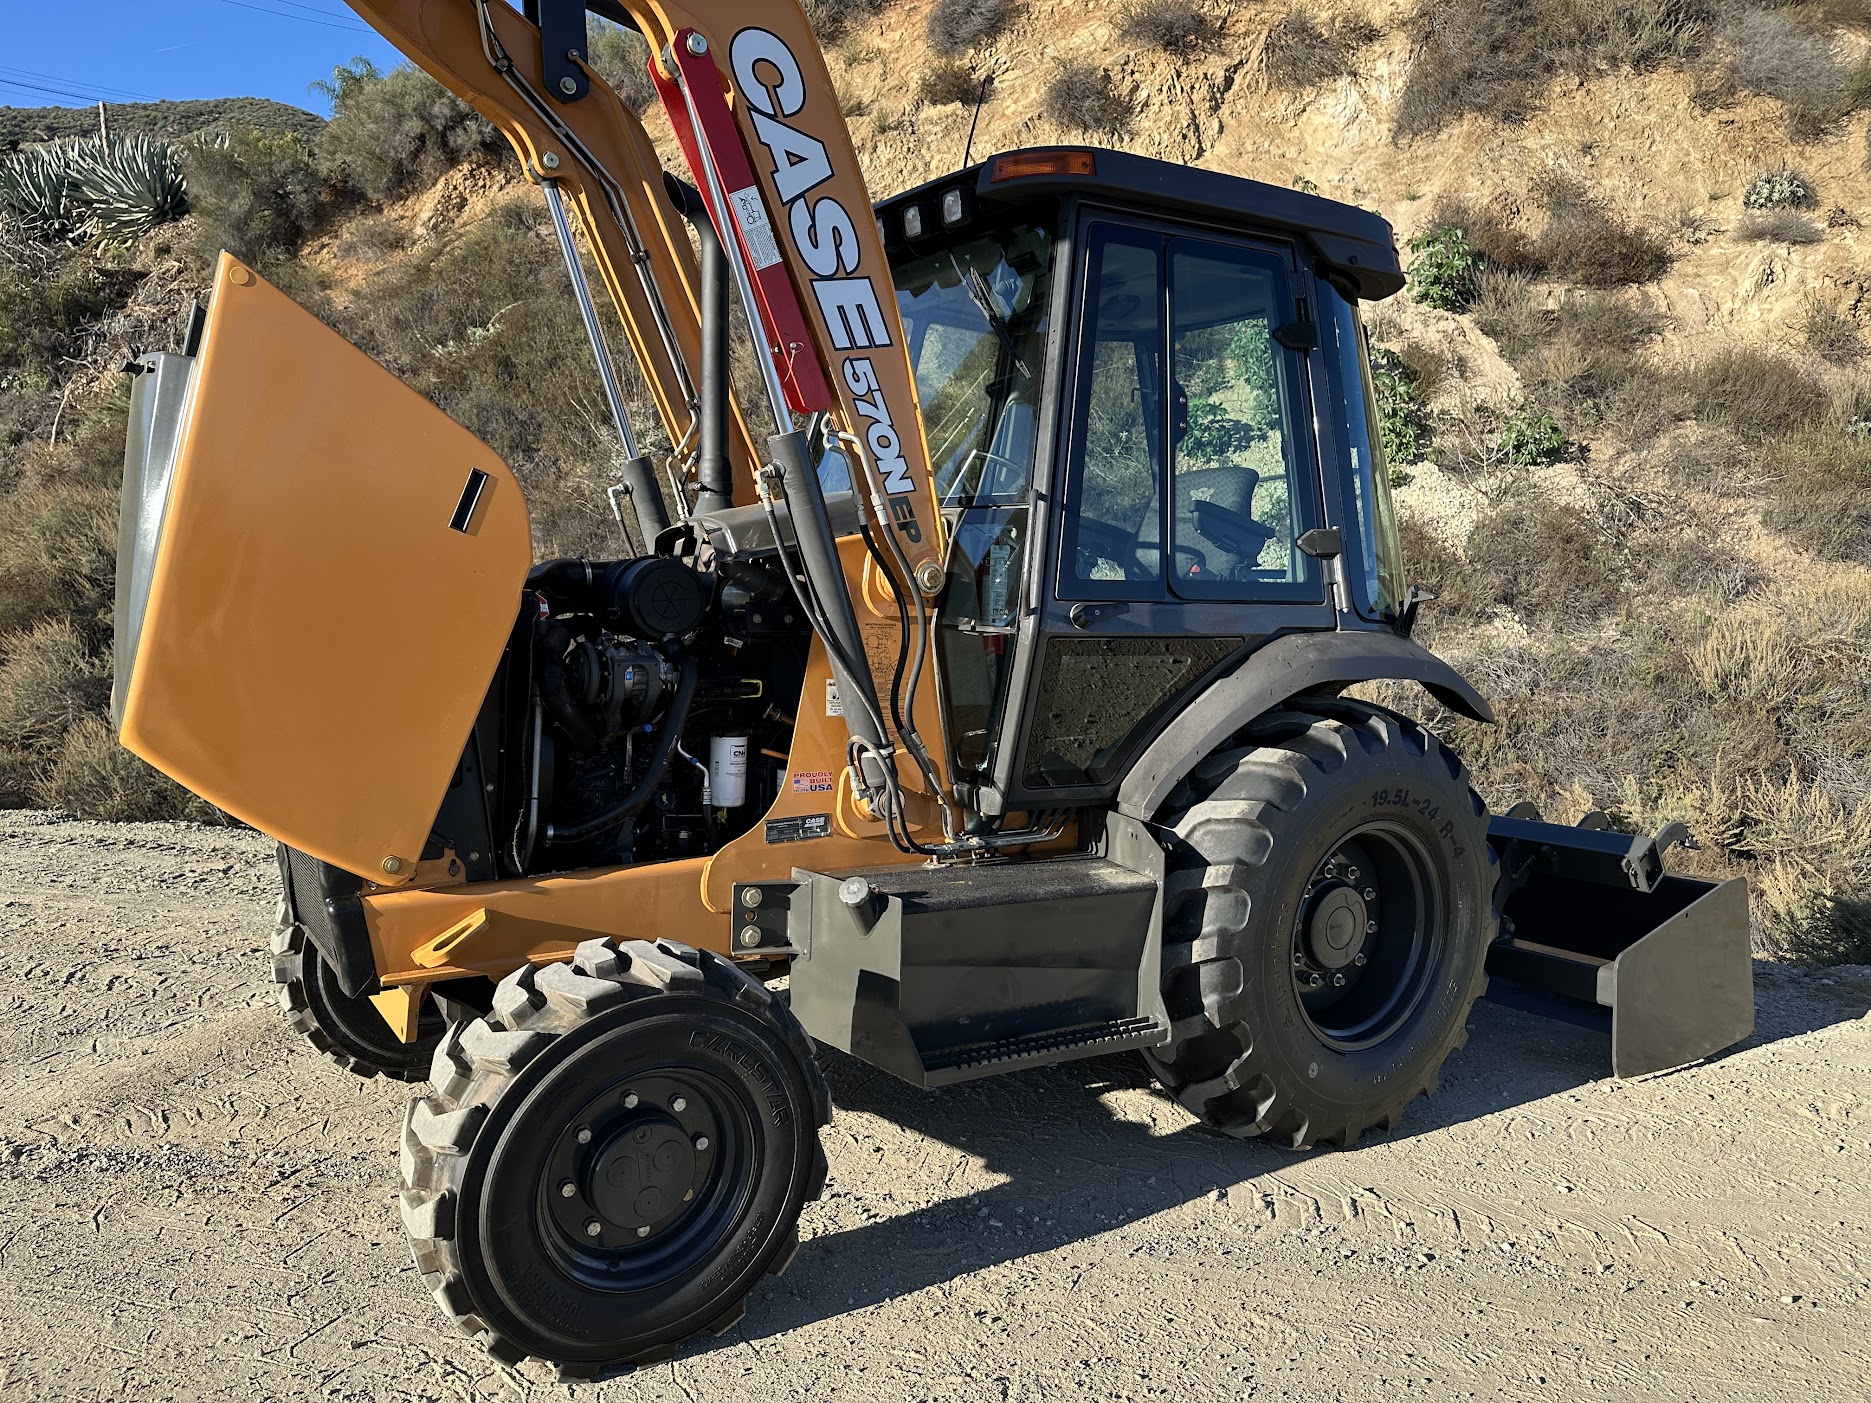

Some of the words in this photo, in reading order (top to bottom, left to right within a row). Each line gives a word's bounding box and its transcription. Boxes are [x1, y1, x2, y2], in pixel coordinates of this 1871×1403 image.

[729, 26, 894, 351] CASE
[842, 356, 916, 495] 570N
[888, 496, 922, 544] EP
[793, 771, 833, 779] PROUDLY
[809, 783, 833, 792] USA
[805, 816, 826, 824] CASE
[1371, 787, 1439, 823] 19.5L-24
[1439, 819, 1466, 861] R-4
[688, 1030, 790, 1128] CARLSTAR
